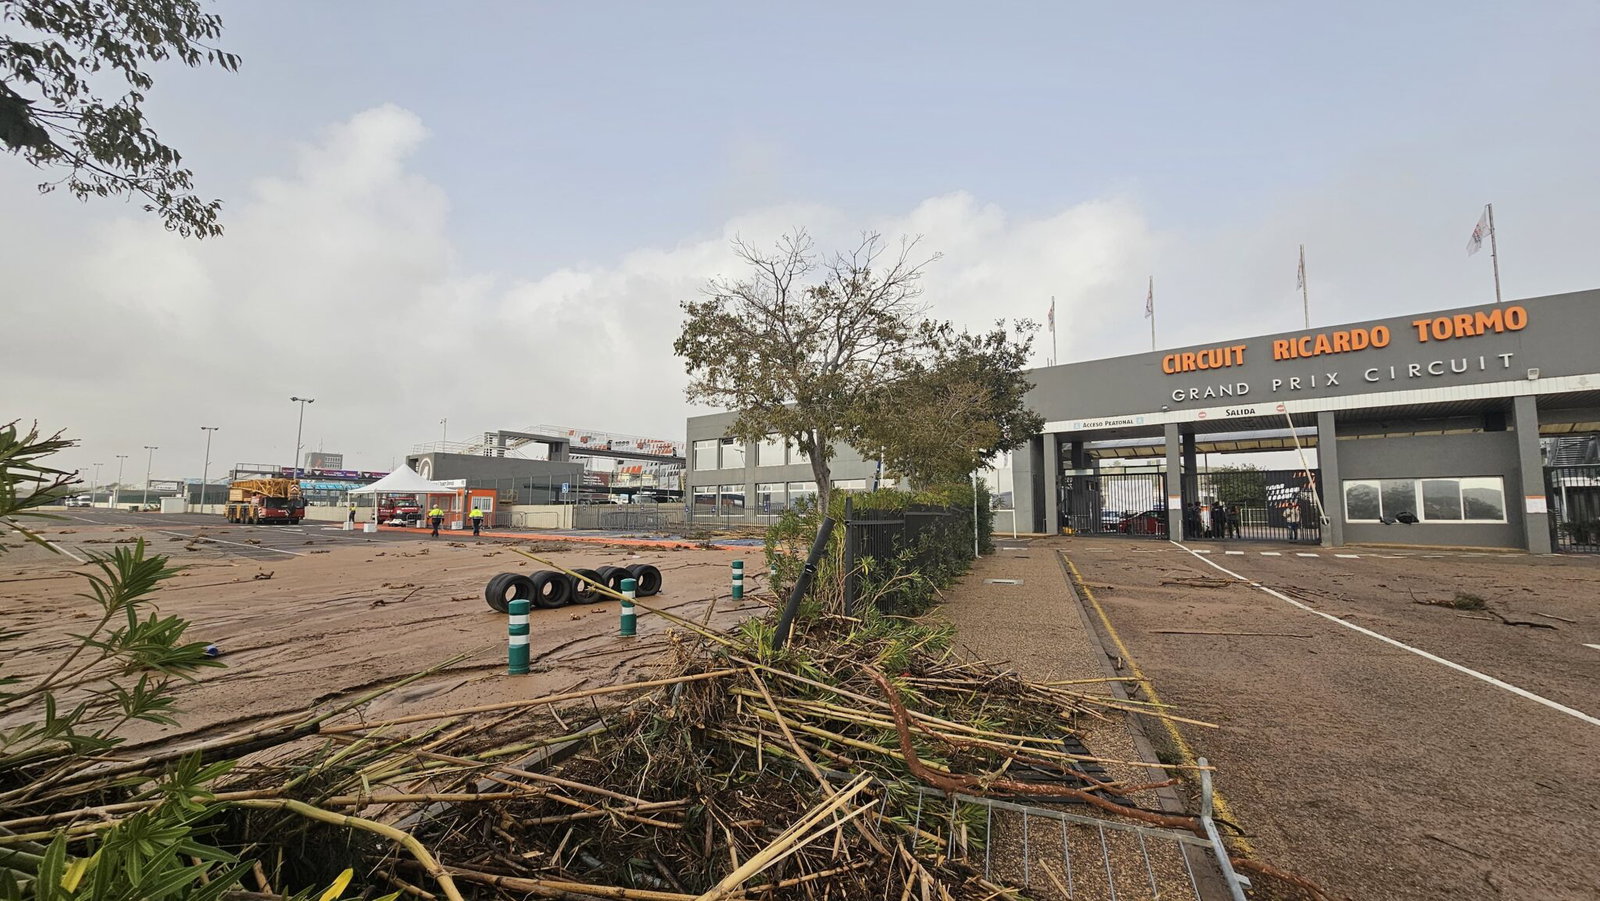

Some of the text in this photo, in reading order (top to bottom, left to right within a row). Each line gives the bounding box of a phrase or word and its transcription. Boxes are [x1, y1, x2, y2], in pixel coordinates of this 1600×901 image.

[1162, 306, 1528, 375] CIRCUIT RICARDO TORMO
[1172, 353, 1514, 402] GRAND PRIX CIRCUIT
[1226, 408, 1256, 417] SALIDA
